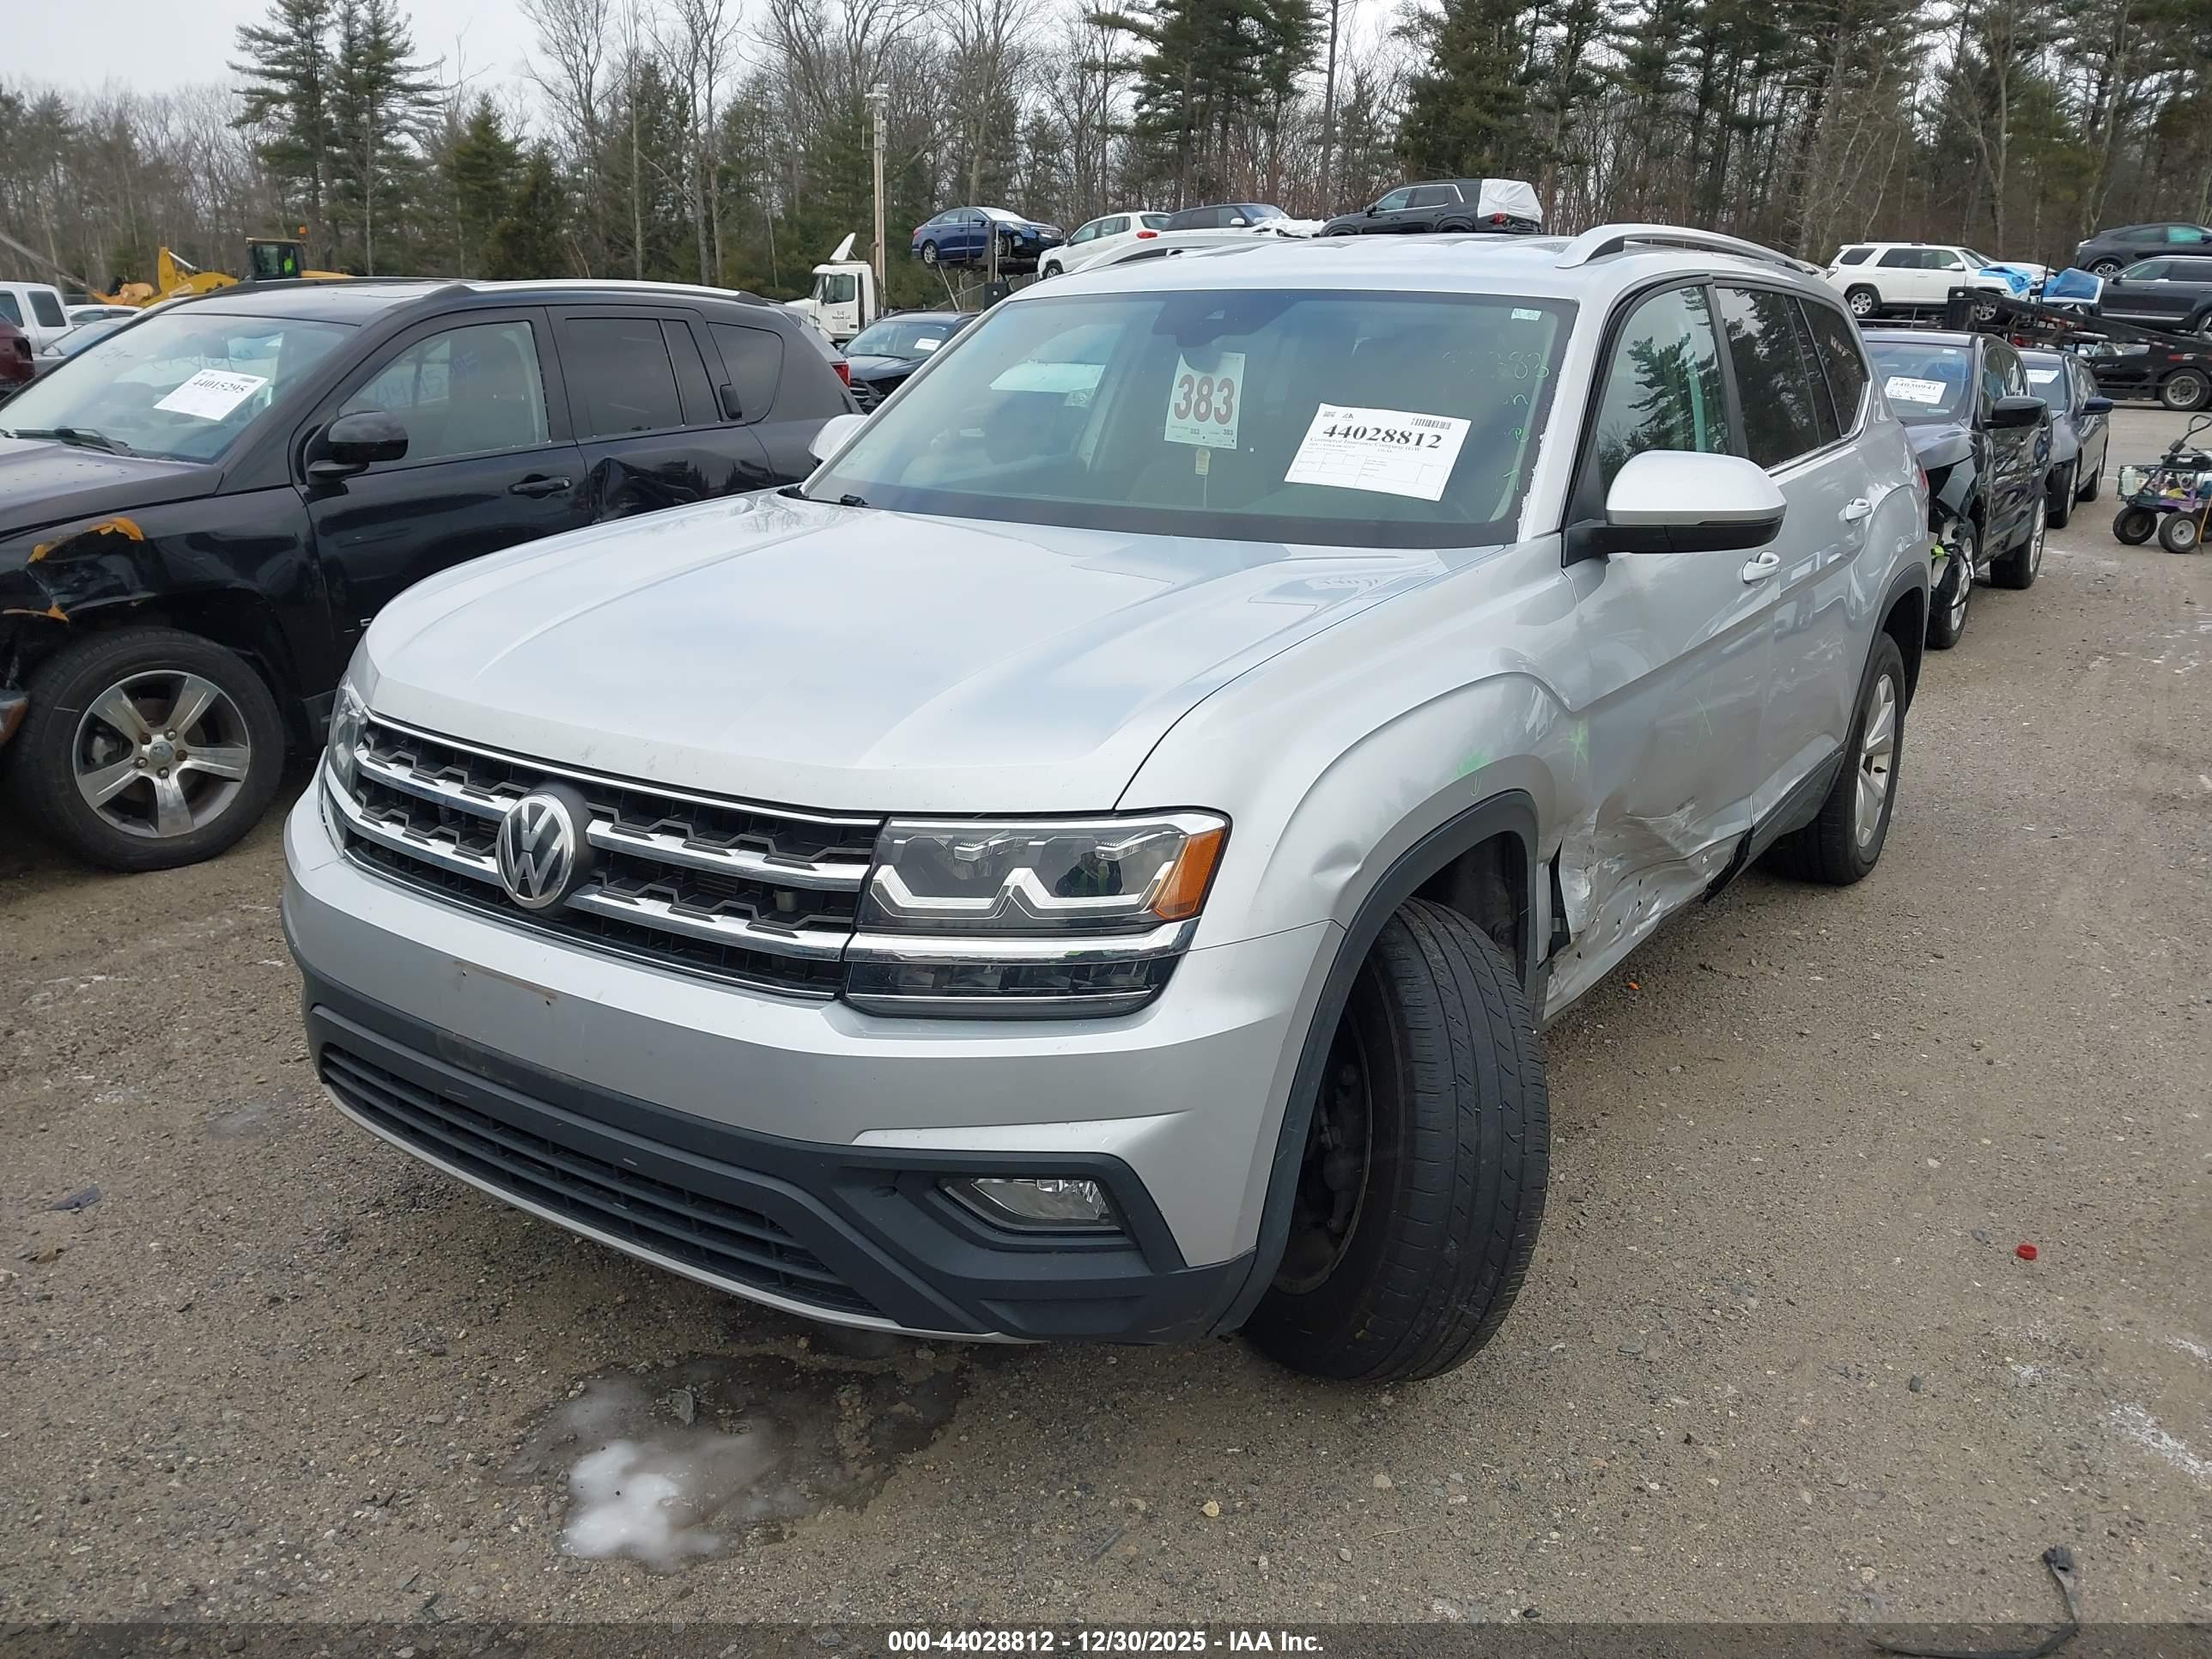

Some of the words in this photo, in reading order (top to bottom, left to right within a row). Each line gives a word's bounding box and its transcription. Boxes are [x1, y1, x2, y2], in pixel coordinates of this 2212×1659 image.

[1174, 374, 1234, 425] 383
[1322, 423, 1443, 449] 44028812
[498, 797, 570, 903] VW
